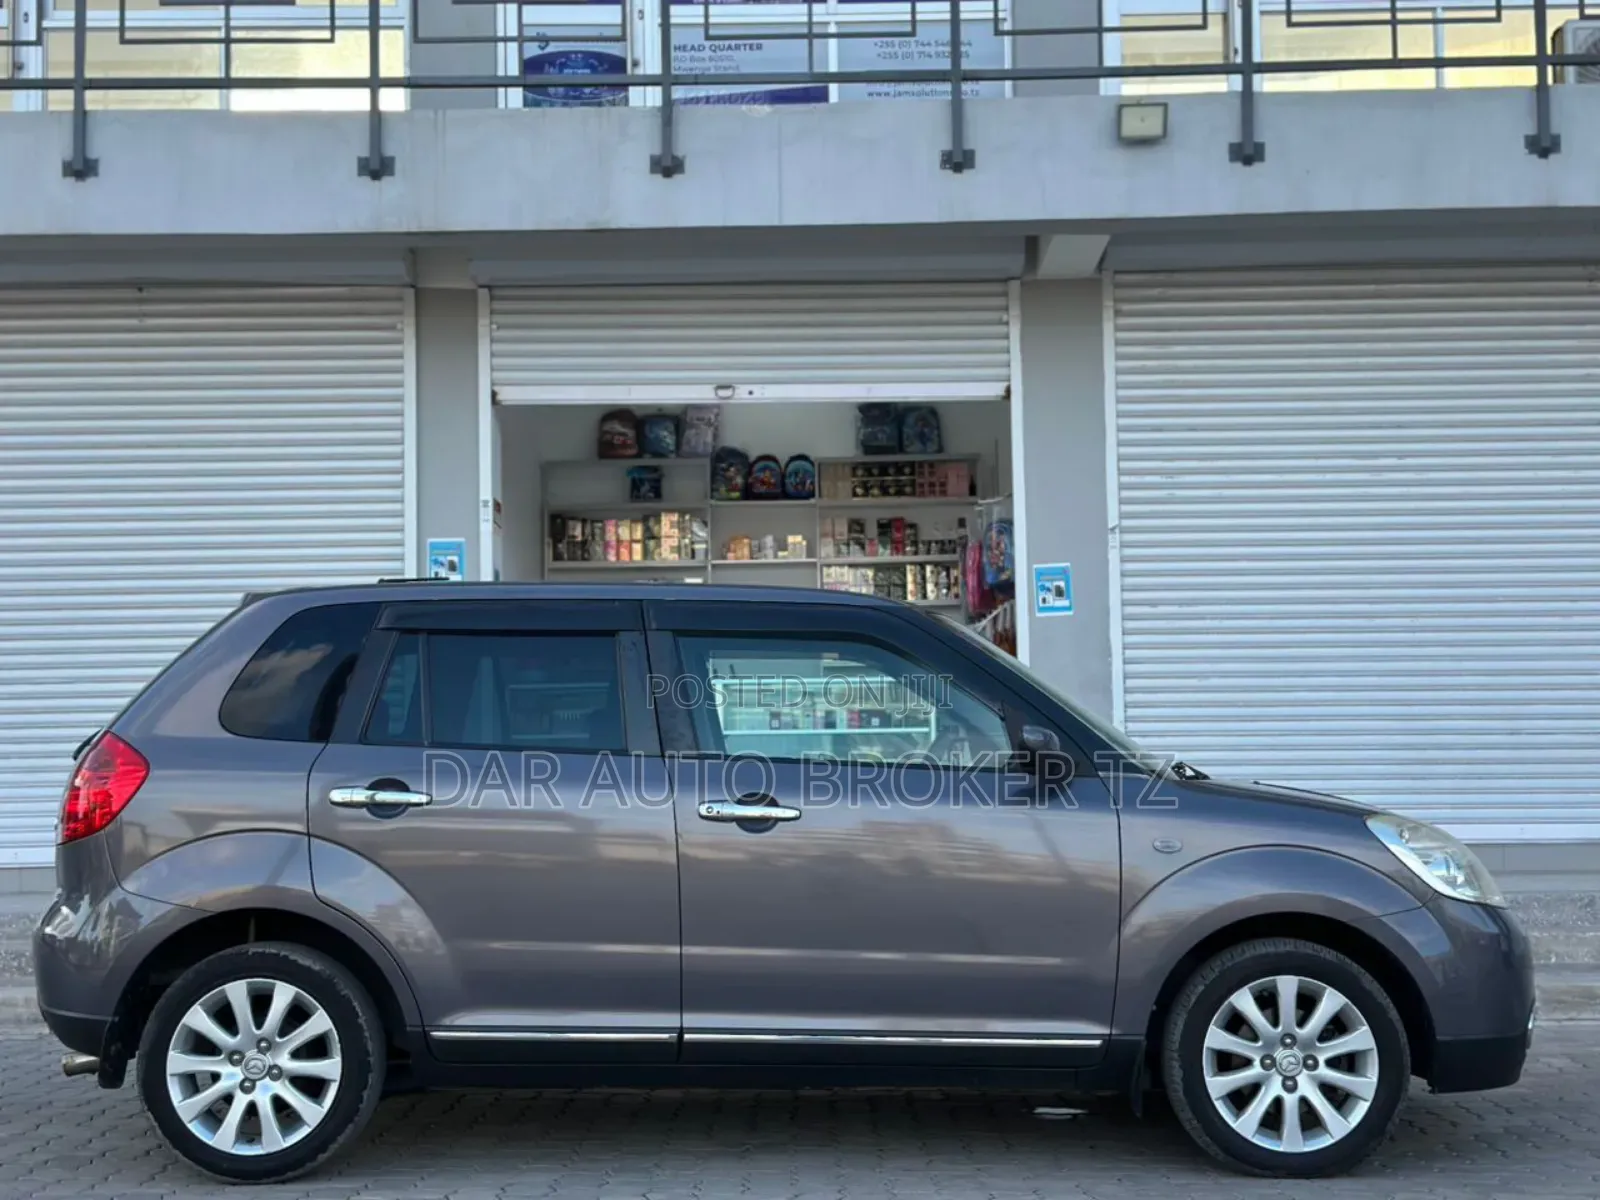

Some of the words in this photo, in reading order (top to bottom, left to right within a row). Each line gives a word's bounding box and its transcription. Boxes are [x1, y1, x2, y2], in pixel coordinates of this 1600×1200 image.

[673, 43, 706, 53] HEAD
[708, 43, 763, 53] QUARTER
[898, 39, 912, 50] (0)
[901, 51, 914, 61] (0)
